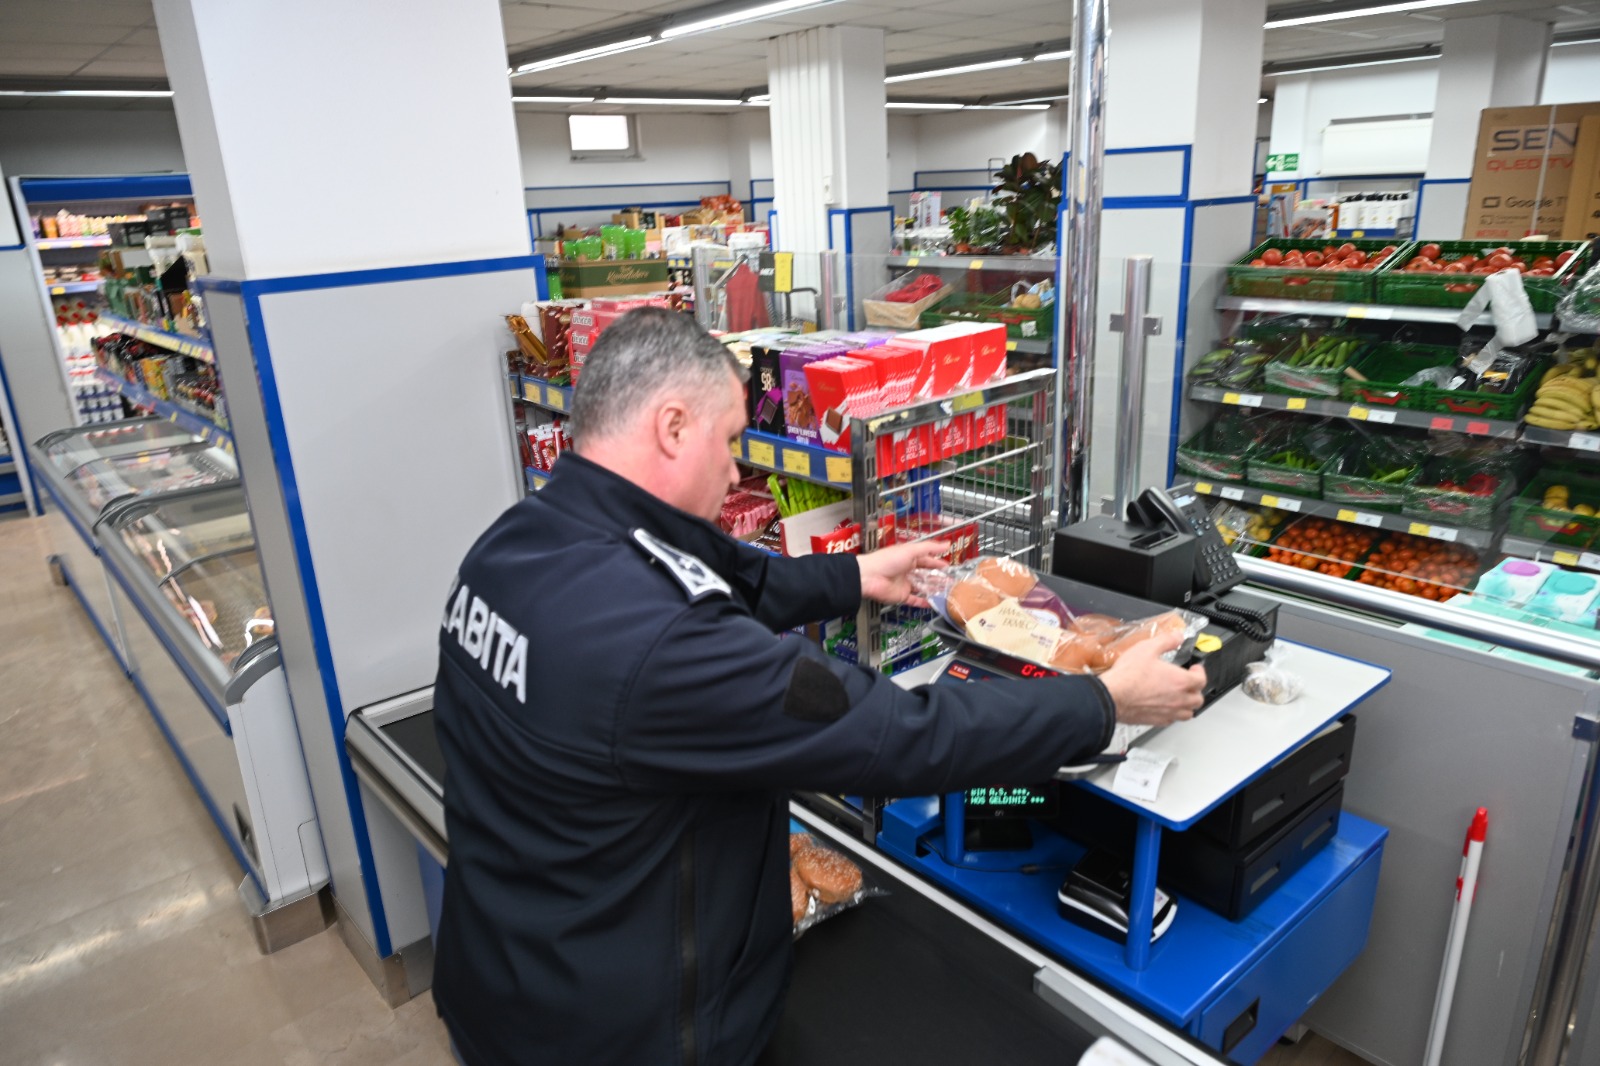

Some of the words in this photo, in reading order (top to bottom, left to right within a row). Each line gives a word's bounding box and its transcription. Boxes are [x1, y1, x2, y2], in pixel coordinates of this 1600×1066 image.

[1491, 127, 1579, 152] SEN
[1504, 196, 1553, 209] Google
[951, 664, 970, 676] TEM
